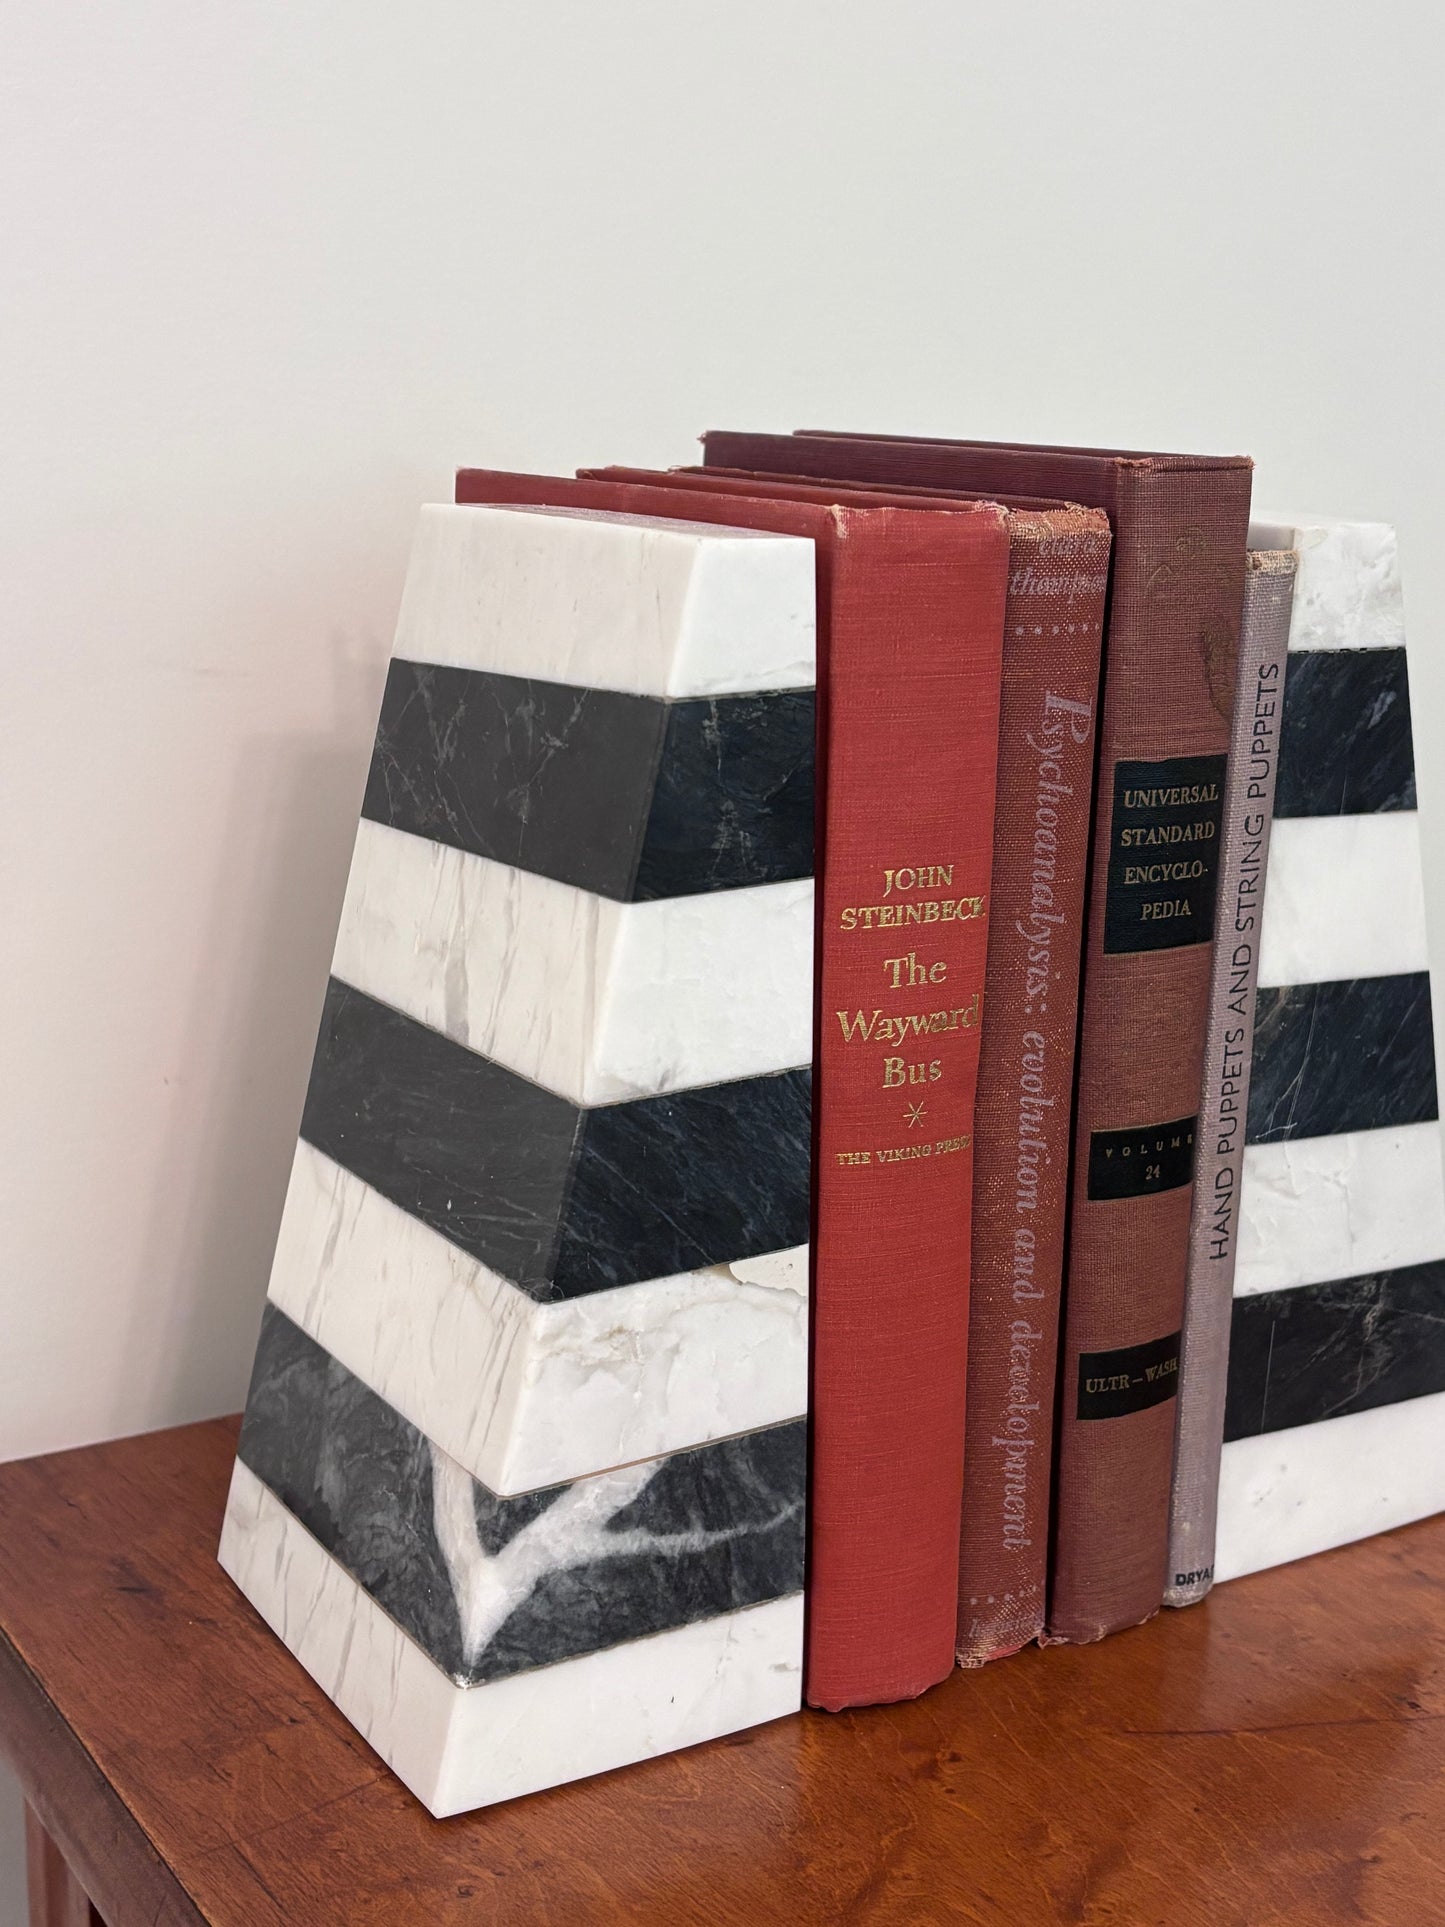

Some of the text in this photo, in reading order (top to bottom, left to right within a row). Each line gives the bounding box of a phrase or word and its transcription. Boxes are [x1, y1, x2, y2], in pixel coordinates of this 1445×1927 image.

[1009, 566, 1107, 604] thompso
[1123, 784, 1219, 809] UNIVERSAL
[1121, 821, 1215, 847] STANDARD
[883, 864, 954, 898] JOHN
[1123, 859, 1209, 885] ENCYCLO-
[840, 895, 986, 930] STEINBECK
[1139, 899, 1192, 921] PEDIA
[883, 952, 947, 989] The
[1209, 663, 1279, 1260] HAND PUPPETS AND STRING PUPPETS
[836, 994, 980, 1047] Wayward
[882, 1056, 942, 1090] Bus
[1016, 1030, 1055, 1213] evolution
[834, 1151, 871, 1165] THE
[875, 1144, 932, 1163] VIKING
[1145, 1163, 1161, 1181] 24
[1012, 1228, 1045, 1303] and
[992, 1319, 1043, 1551] development
